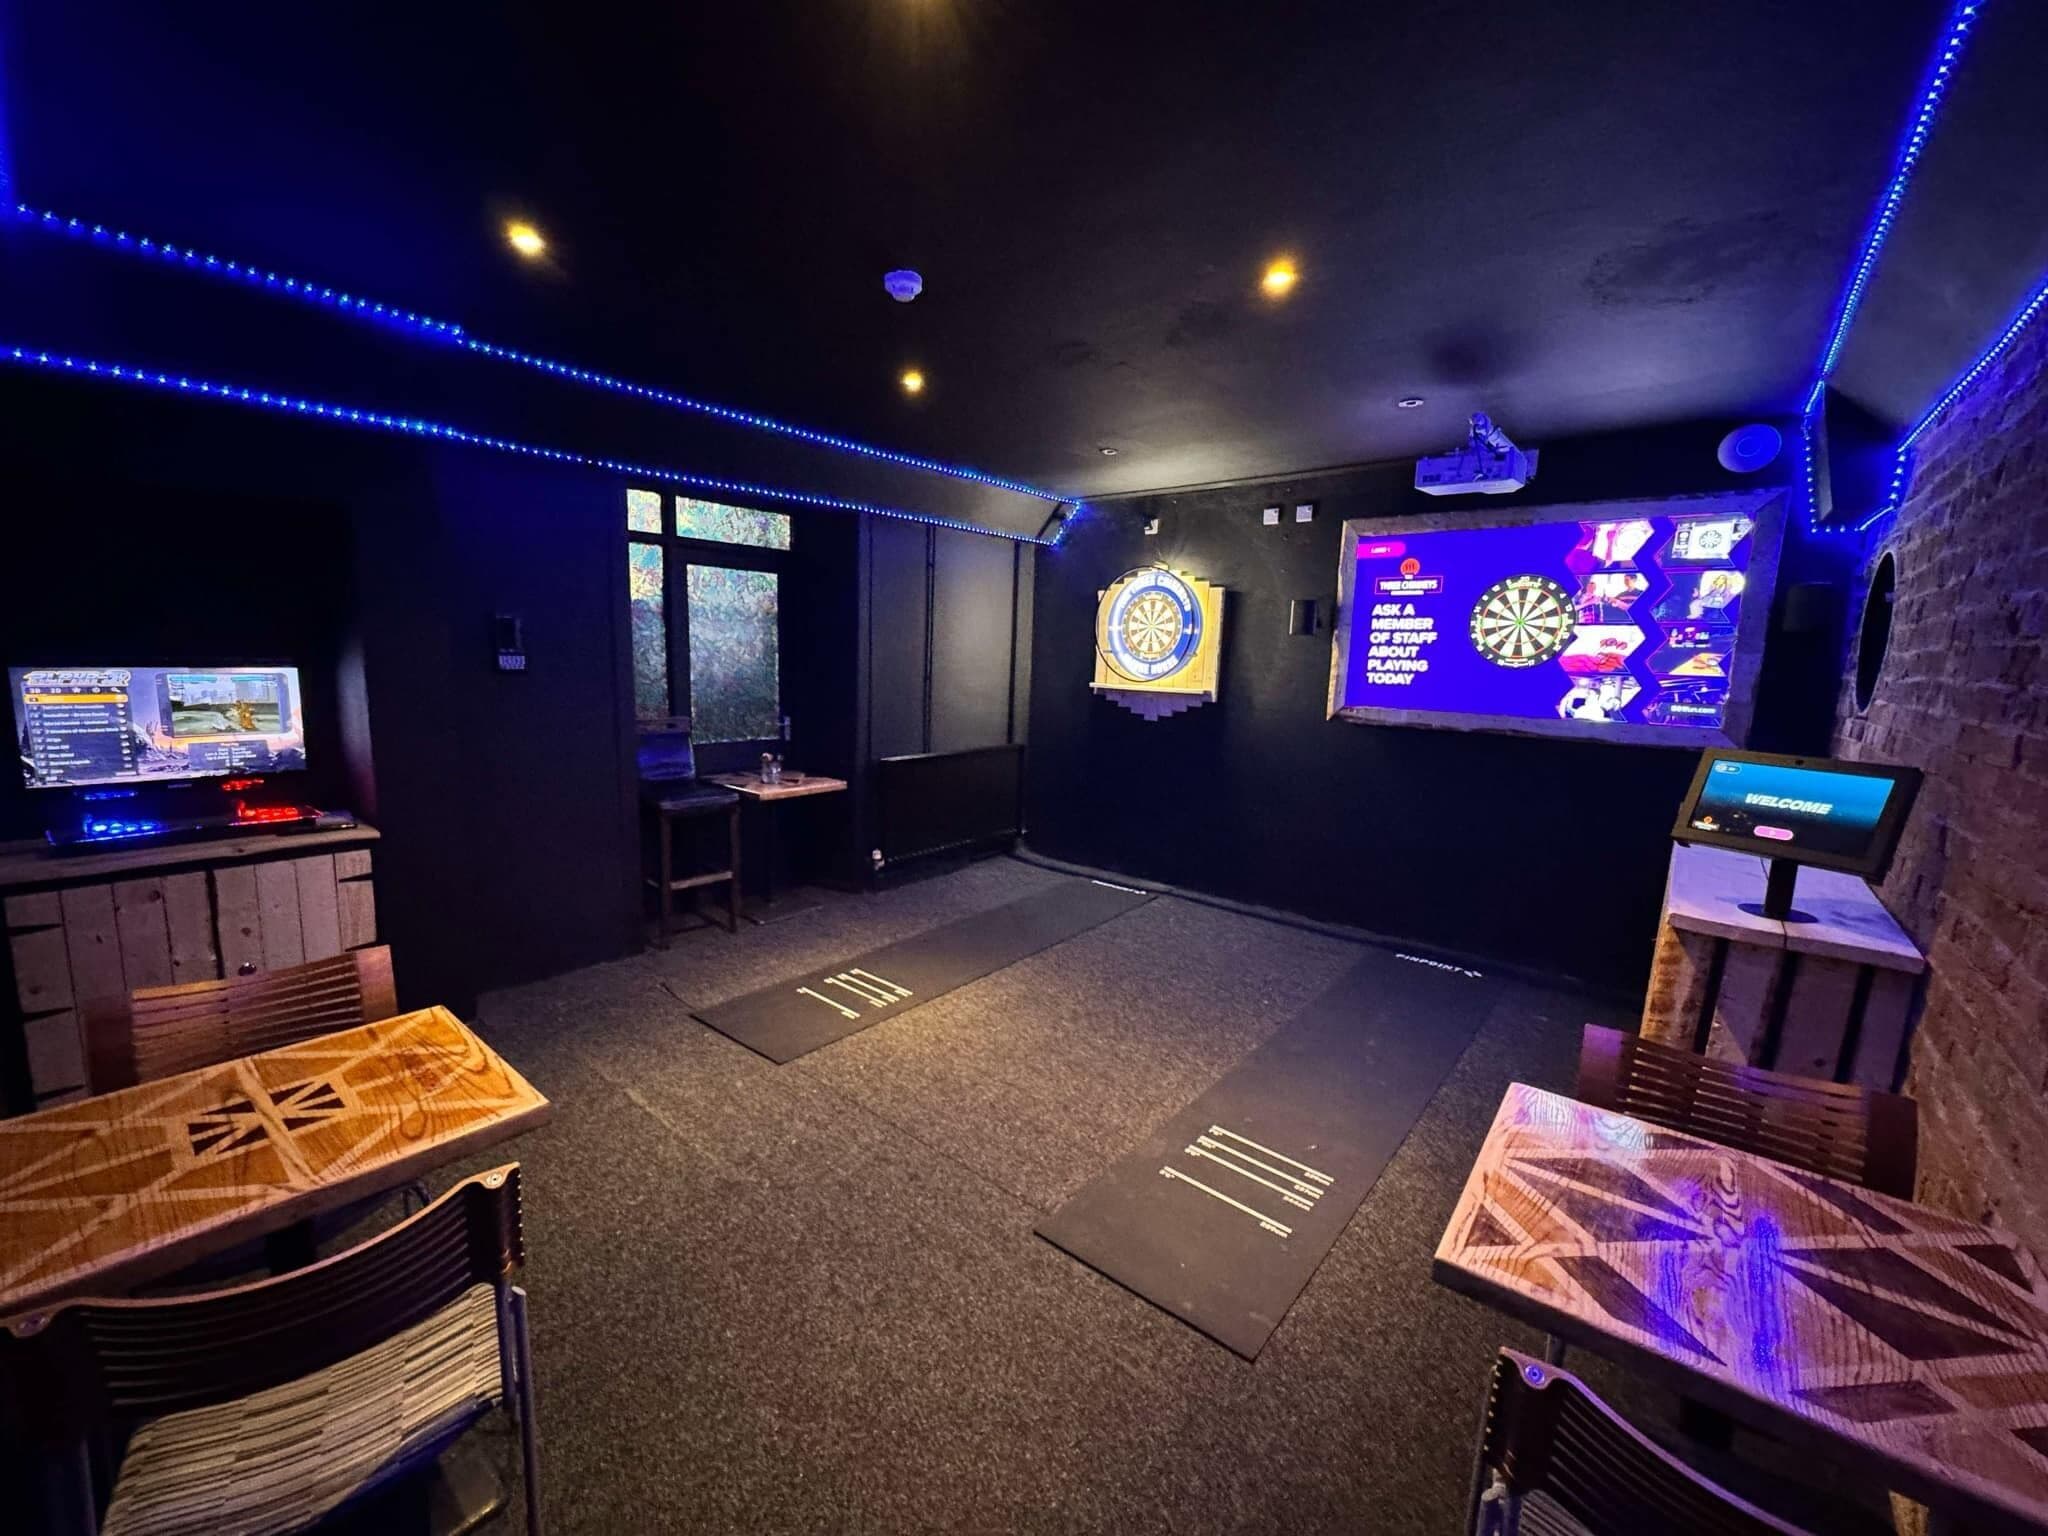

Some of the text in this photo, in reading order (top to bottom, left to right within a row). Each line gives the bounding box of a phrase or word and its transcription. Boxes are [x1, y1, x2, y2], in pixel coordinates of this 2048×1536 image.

[1371, 603, 1416, 616] ASK A
[1371, 617, 1434, 630] MEMBER
[1369, 631, 1438, 644] OF STAFF
[1367, 645, 1420, 658] ABOUT
[1367, 658, 1429, 672] PLAYING
[1366, 672, 1415, 685] TODAY
[1744, 792, 1833, 815] WELCOME
